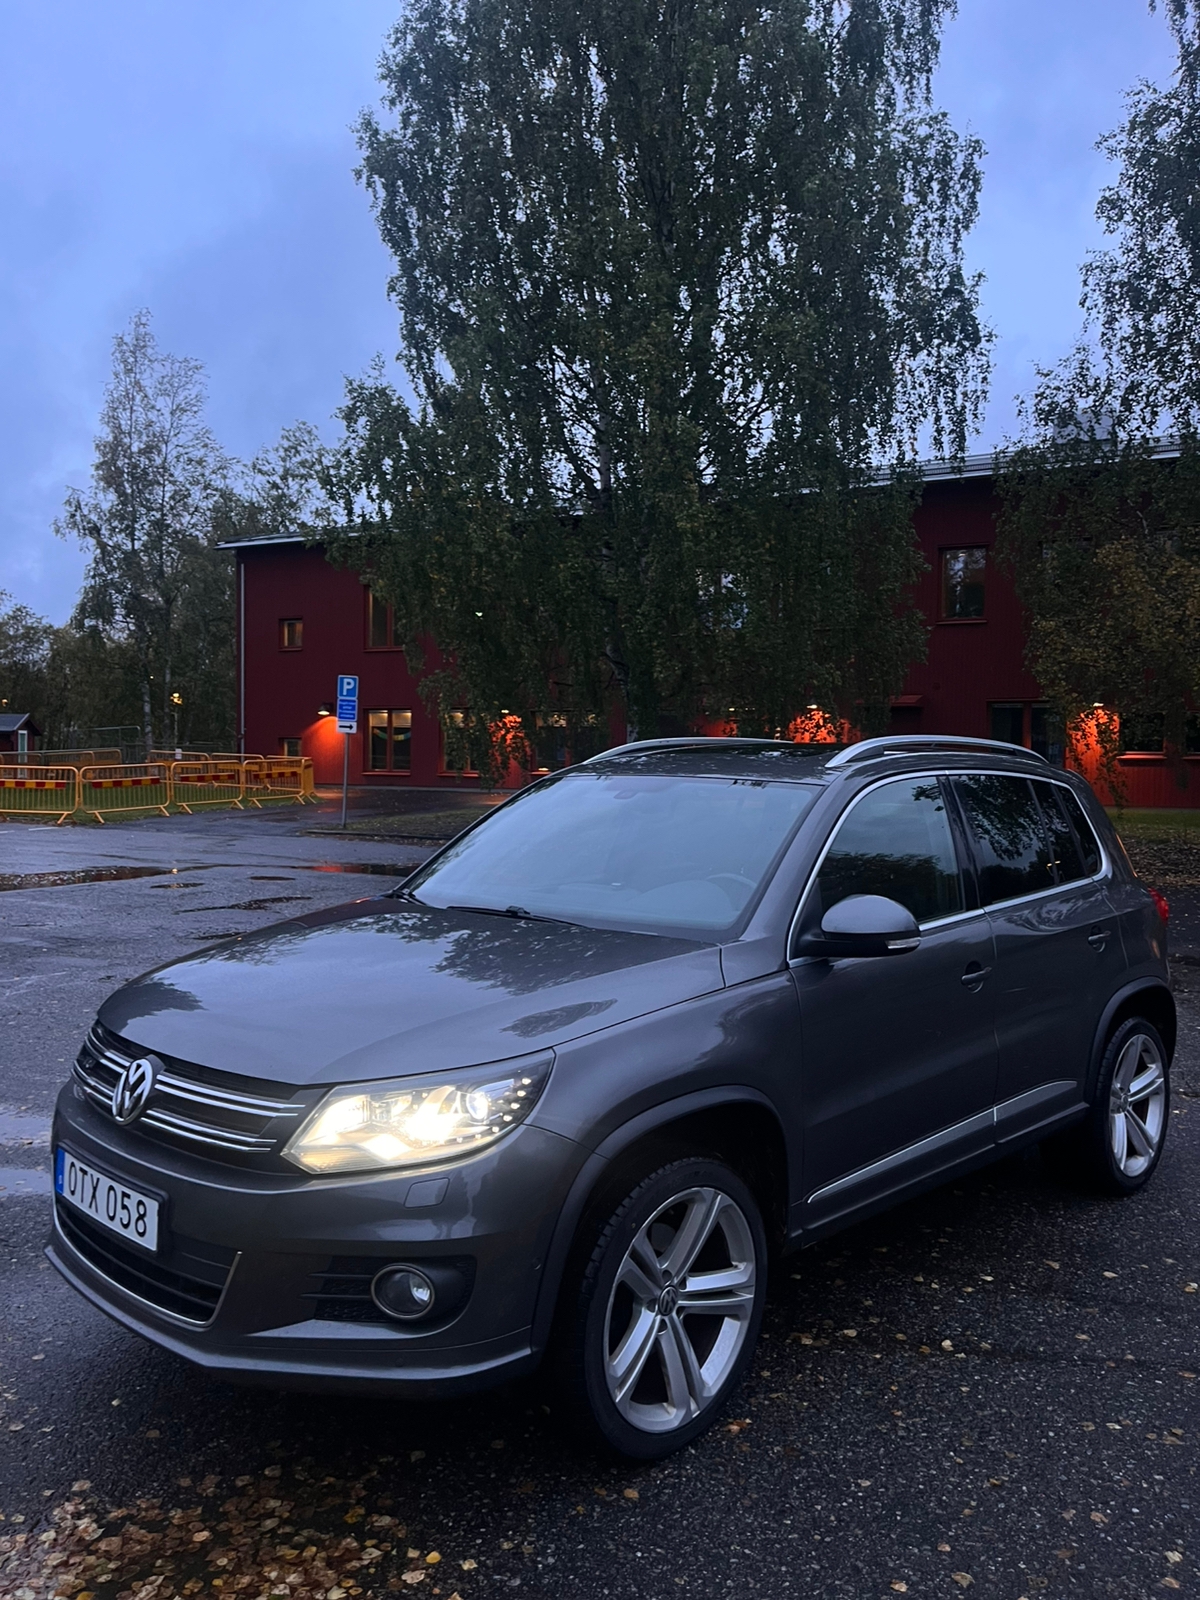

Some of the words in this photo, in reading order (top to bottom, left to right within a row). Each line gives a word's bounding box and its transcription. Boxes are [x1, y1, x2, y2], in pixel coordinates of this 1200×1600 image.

[342, 678, 355, 696] P
[68, 1161, 101, 1214] OTX
[106, 1184, 148, 1238] 058
